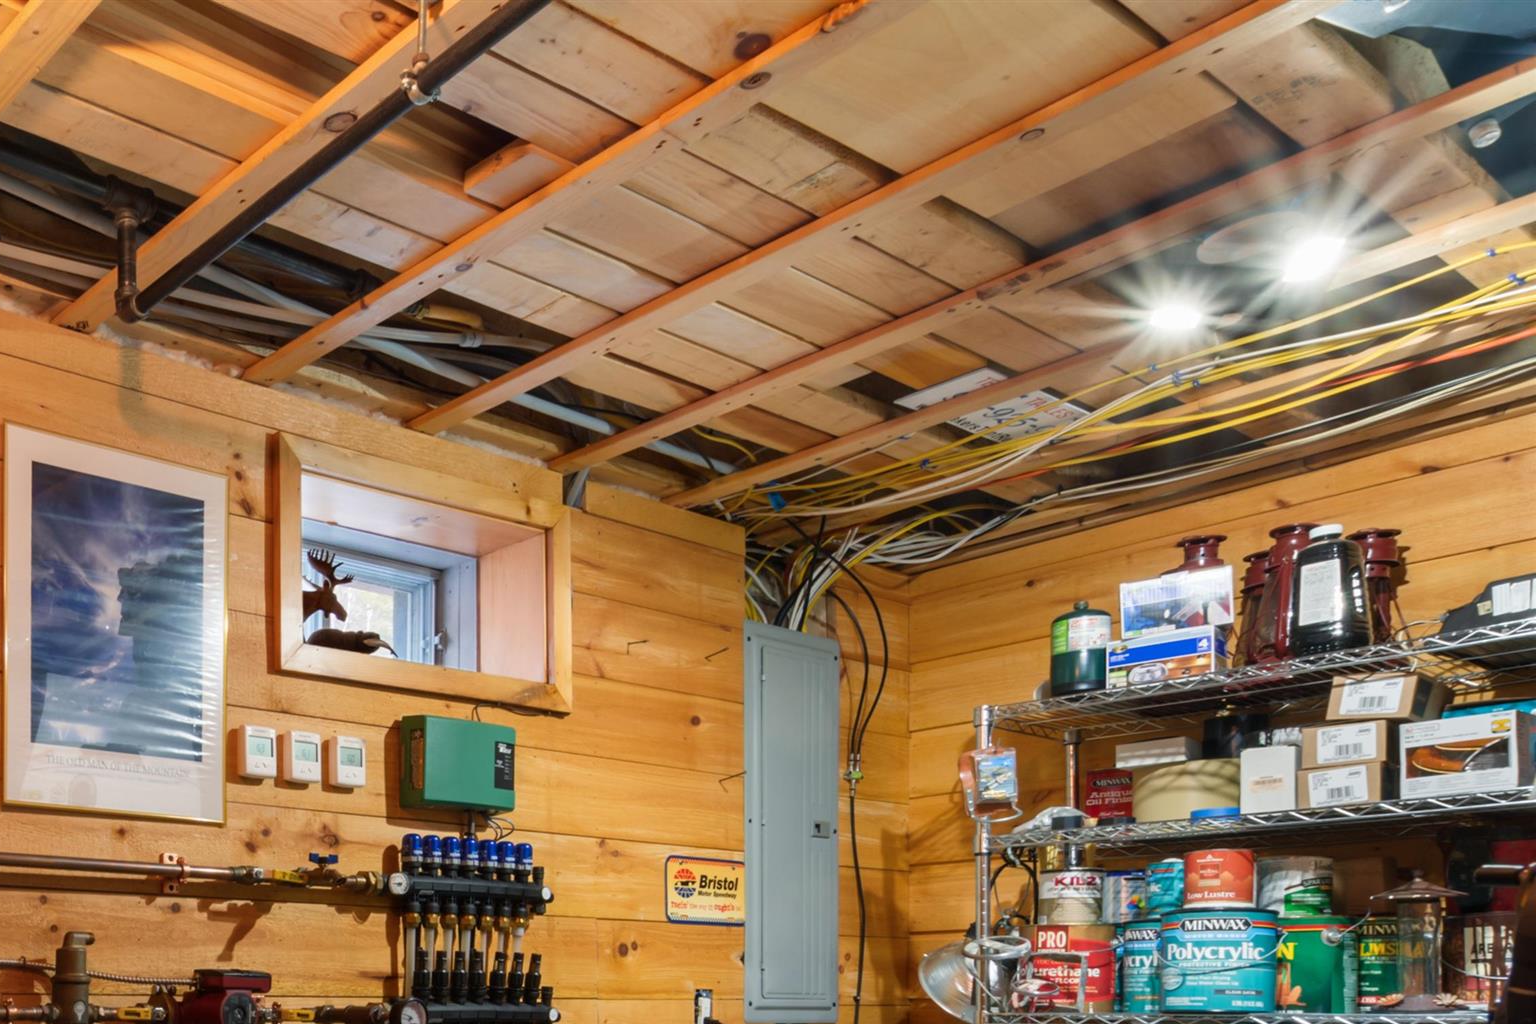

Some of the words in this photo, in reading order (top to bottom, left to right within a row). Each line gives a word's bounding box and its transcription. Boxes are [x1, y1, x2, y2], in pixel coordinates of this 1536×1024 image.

[1197, 637, 1209, 650] 4
[1095, 777, 1132, 787] MINWAX
[1086, 797, 1102, 806] Oil
[699, 874, 739, 891] Bristol
[713, 891, 737, 900] Speedway
[1184, 918, 1249, 931] MINWAX
[1037, 930, 1067, 948] PRO
[1167, 941, 1265, 962] Polycrylic
